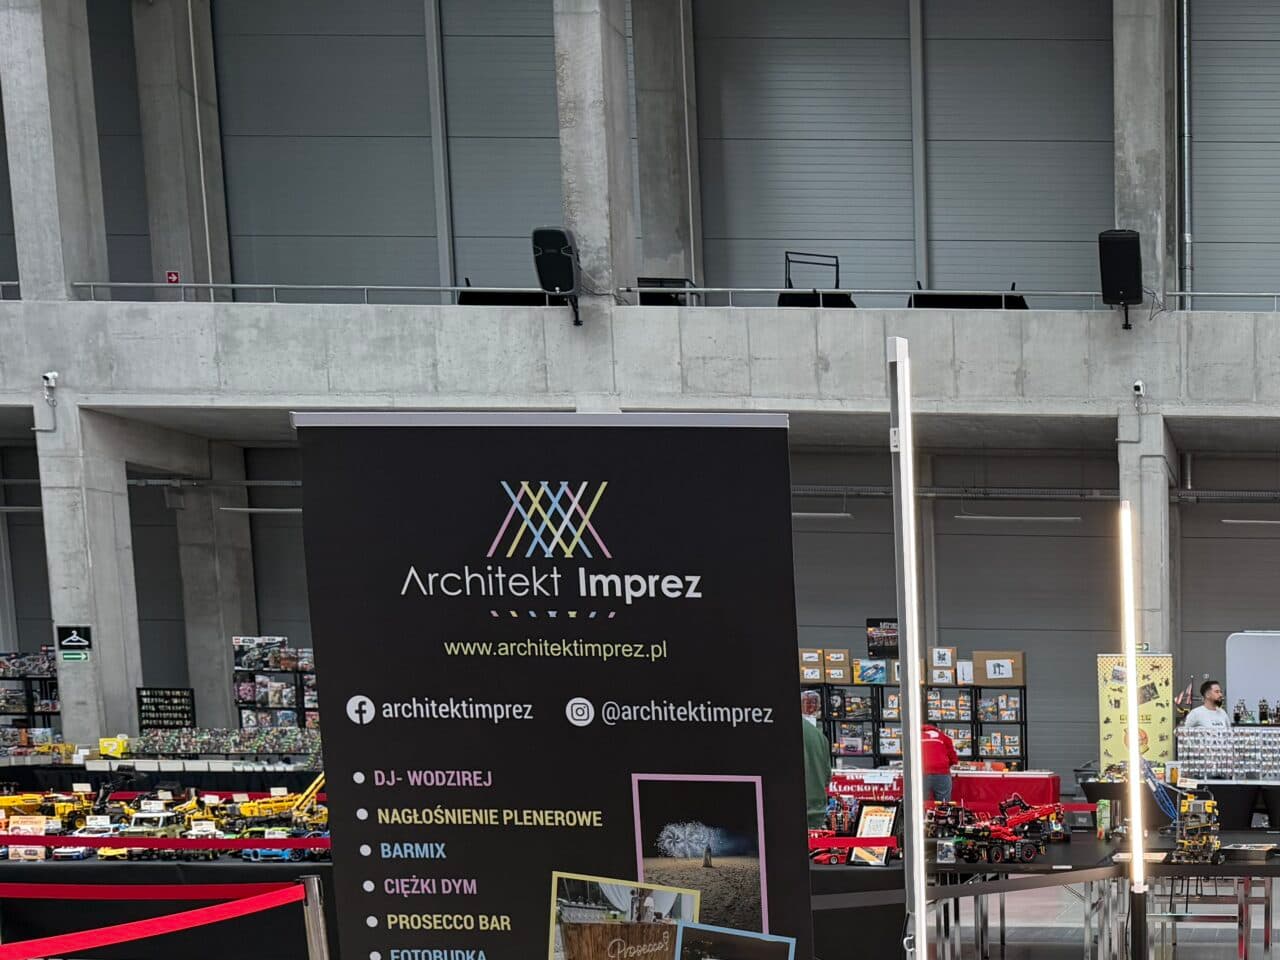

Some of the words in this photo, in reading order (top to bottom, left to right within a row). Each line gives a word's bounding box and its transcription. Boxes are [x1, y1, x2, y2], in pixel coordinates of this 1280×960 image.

[401, 566, 561, 596] Architekt
[579, 567, 701, 604] Imprez
[445, 639, 666, 661] www.architektimprez.pl
[383, 698, 533, 723] architektimprez
[602, 700, 773, 727] @architektimprez
[375, 771, 402, 785] DJ-
[407, 771, 491, 786] WODZIREJ
[378, 805, 498, 824] NAGŁOŚNIENIE
[503, 810, 602, 826] PLENEROWE
[381, 843, 446, 858] BARMIX
[385, 875, 436, 897] CIĘŻKI
[442, 879, 476, 894] DYM
[387, 914, 474, 929] PROSECCO
[479, 915, 511, 930] BAR
[607, 938, 664, 960] Prosecco
